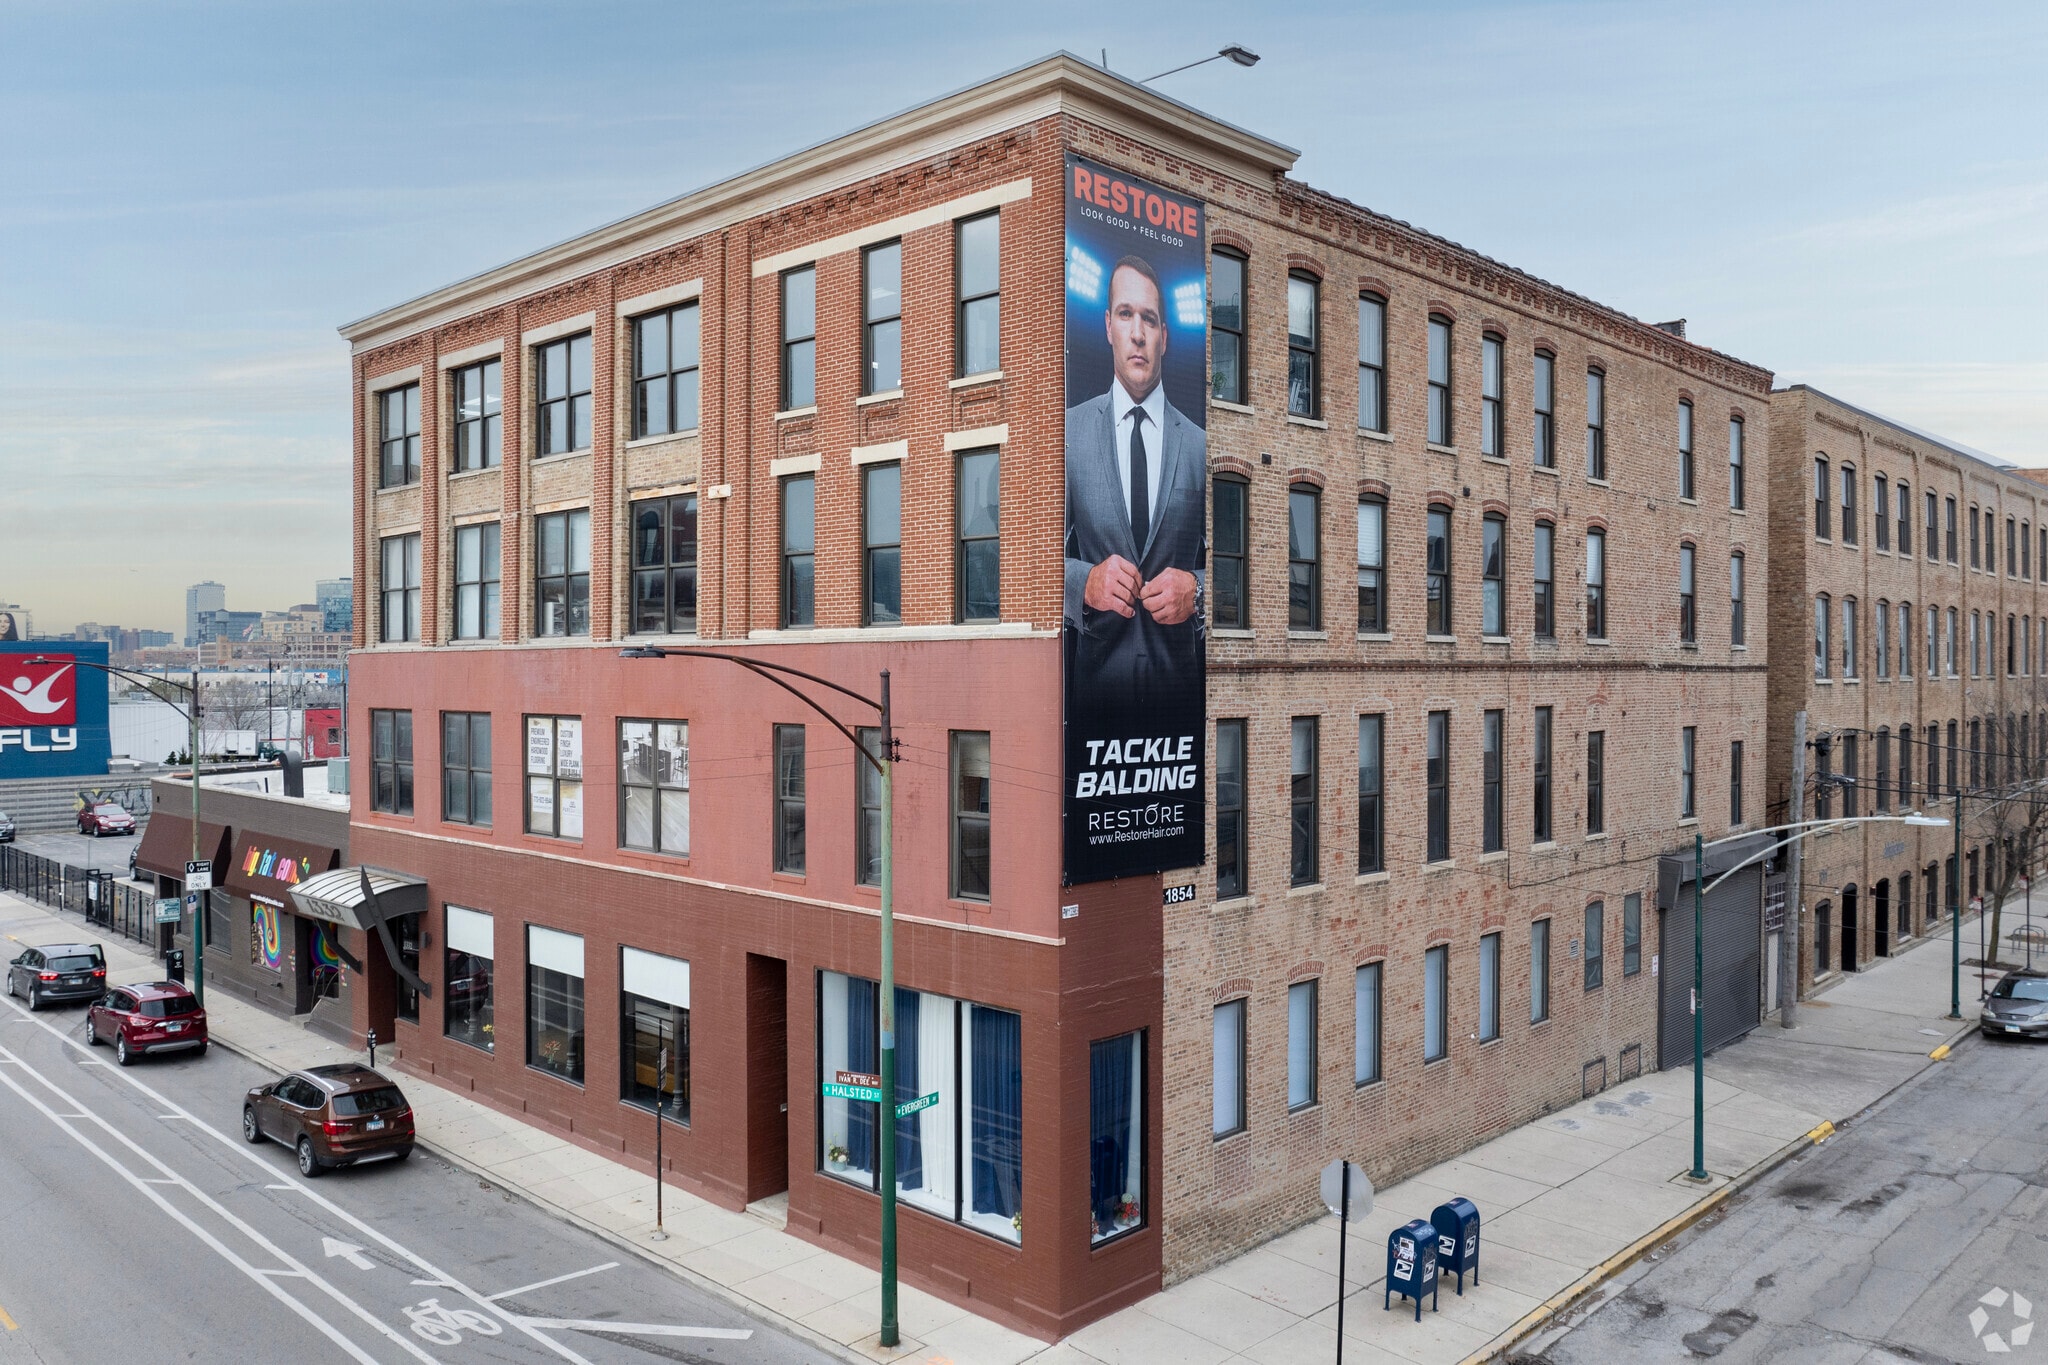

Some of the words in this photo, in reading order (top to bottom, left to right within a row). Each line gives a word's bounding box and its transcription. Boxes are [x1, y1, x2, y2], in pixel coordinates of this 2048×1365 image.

[1074, 166, 1198, 238] RESTORE
[1080, 206, 1104, 222] LOOK
[1106, 215, 1130, 230] GOOD
[1140, 226, 1159, 240] FEEL
[1161, 233, 1184, 248] GOOD
[1086, 736, 1194, 766] TACKLE
[1075, 764, 1197, 799] BALDING
[1088, 803, 1185, 831] RESTORE
[1089, 825, 1184, 845] www.RestoreHair.com
[1165, 885, 1193, 903] 1854
[306, 898, 345, 922] 1332
[831, 1085, 872, 1099] HALSTED
[838, 1075, 851, 1083] IVAN
[860, 1077, 870, 1086] DEE
[901, 1096, 930, 1116] EVERGREEN
